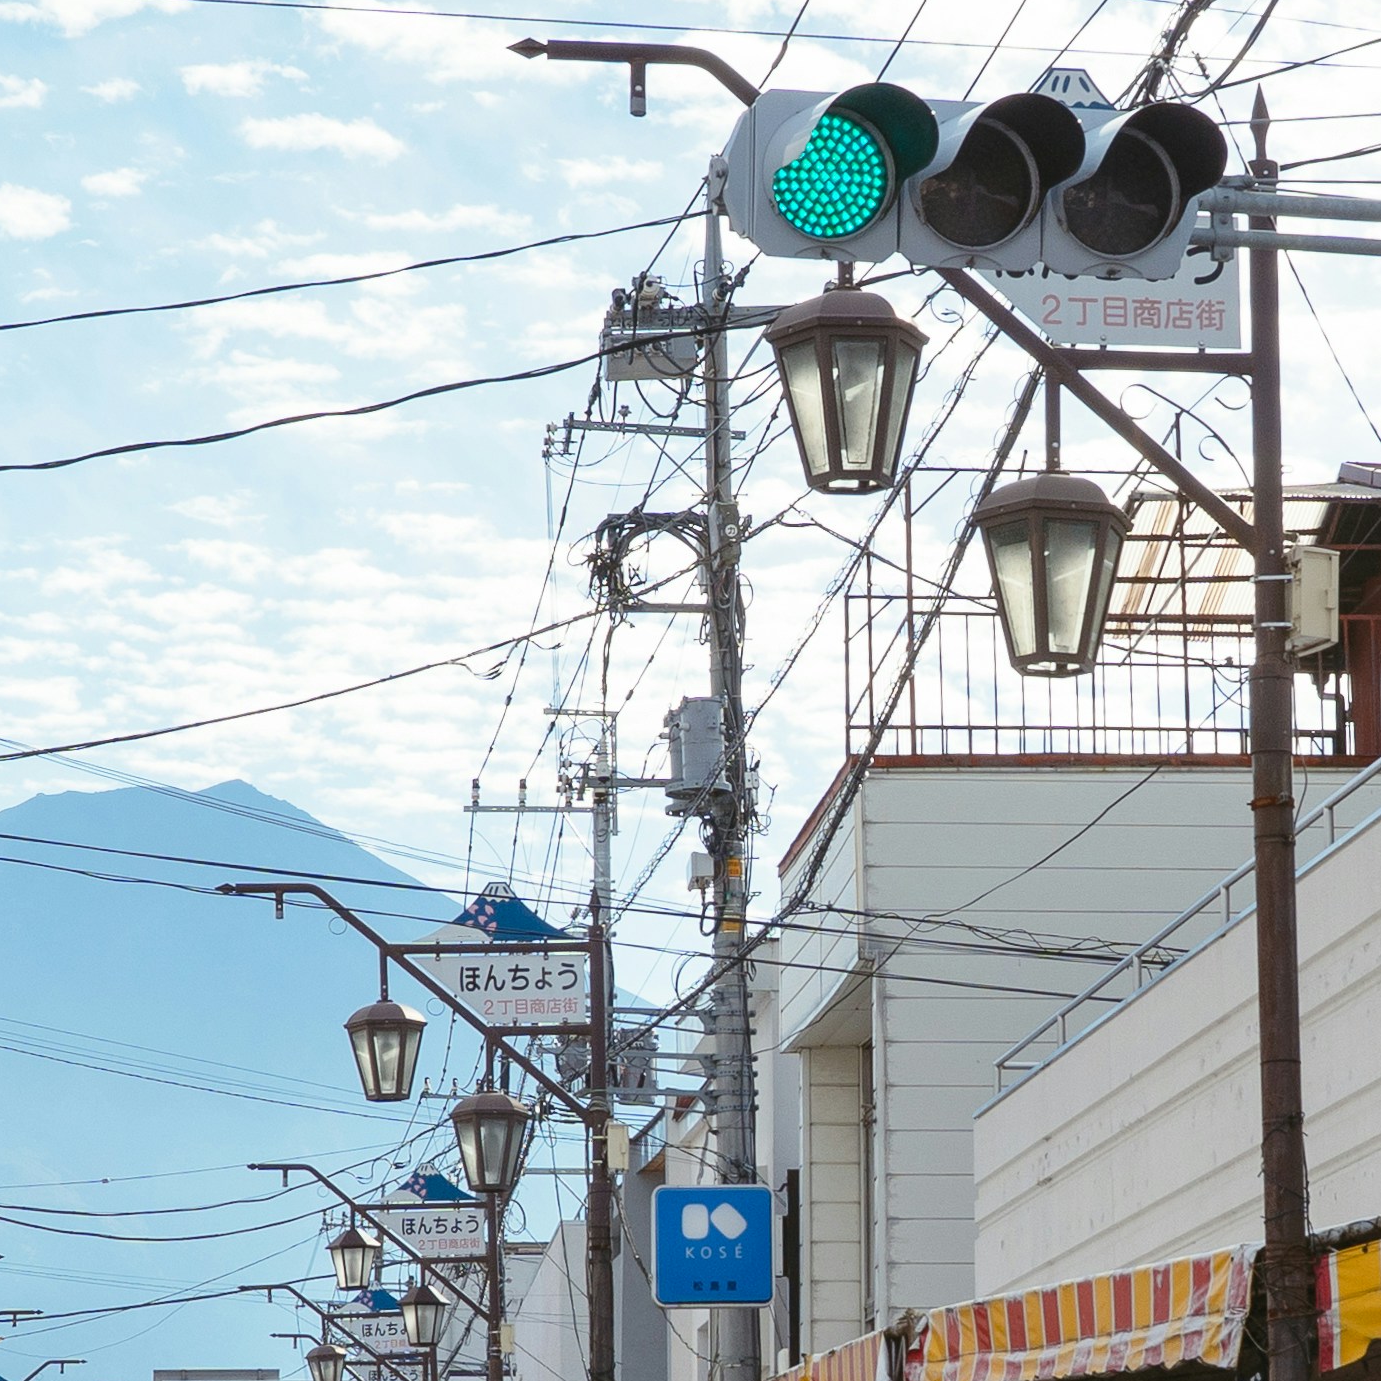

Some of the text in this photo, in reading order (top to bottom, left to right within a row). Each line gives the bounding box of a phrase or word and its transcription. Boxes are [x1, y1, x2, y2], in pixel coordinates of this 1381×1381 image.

[1041, 294, 1226, 331] 2丁目商店街
[459, 962, 578, 993] ほんちょう
[483, 997, 579, 1016] 2丁目商店街
[401, 1214, 480, 1236] ほんちょう
[685, 1242, 743, 1259] KOSÉ
[362, 1322, 407, 1337] ほんちょ
